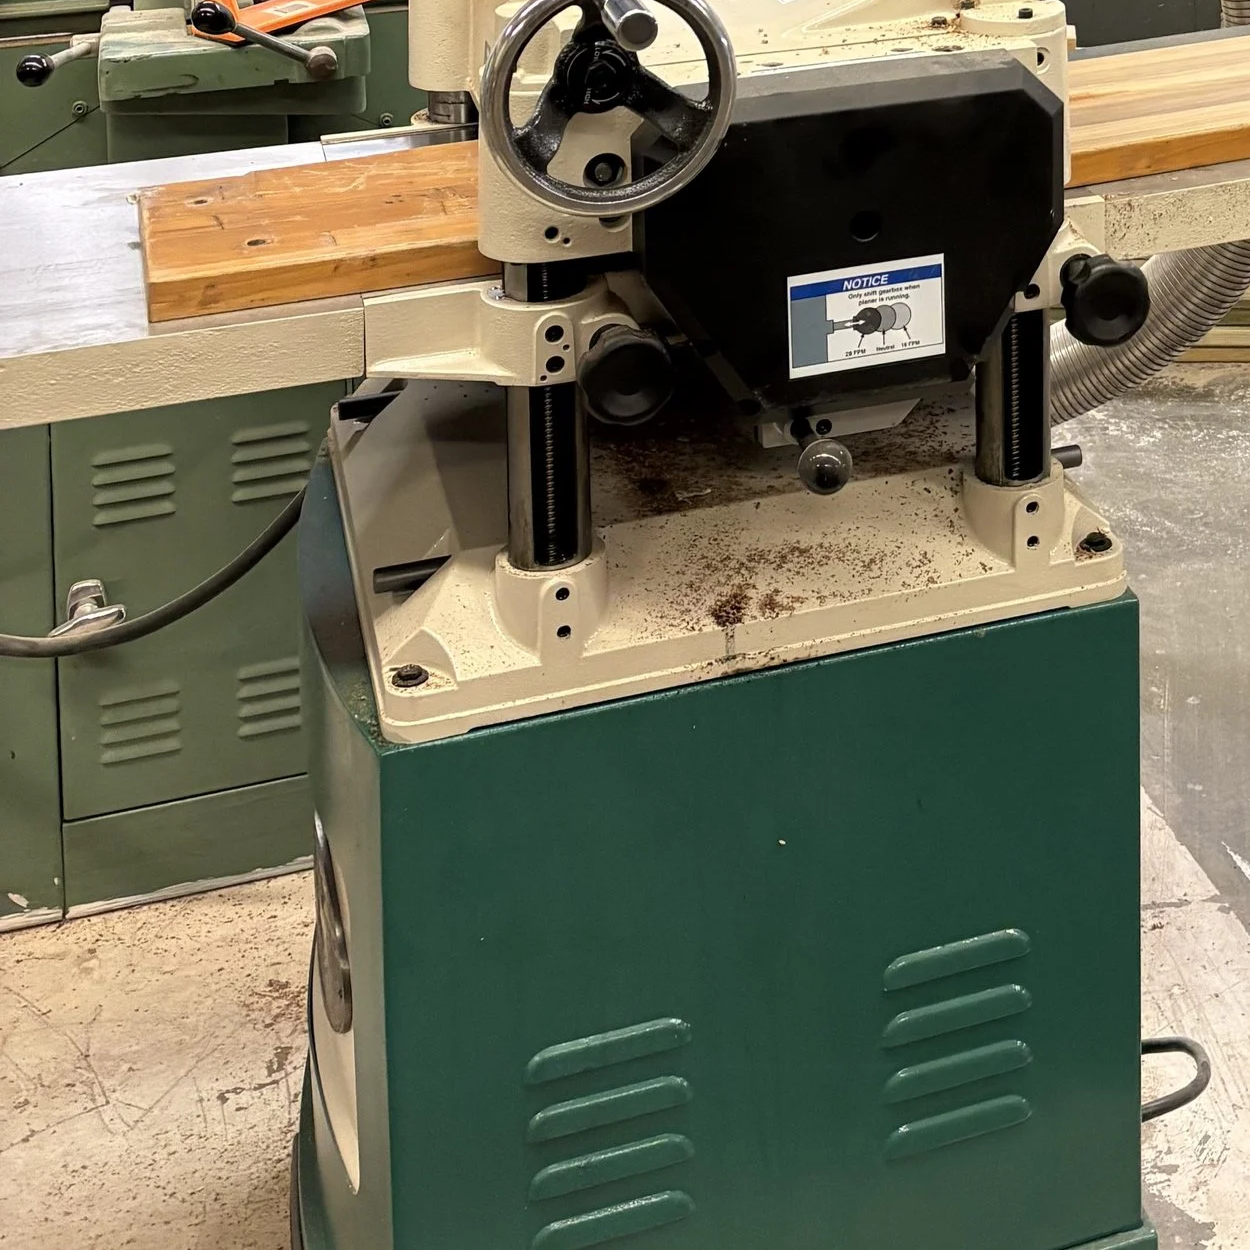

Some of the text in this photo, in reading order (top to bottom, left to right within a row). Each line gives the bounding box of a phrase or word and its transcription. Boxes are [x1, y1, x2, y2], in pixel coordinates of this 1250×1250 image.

[843, 274, 889, 291] NOTICE
[848, 292, 862, 300] Only
[879, 287, 903, 295] gearbox
[858, 298, 877, 306] planer
